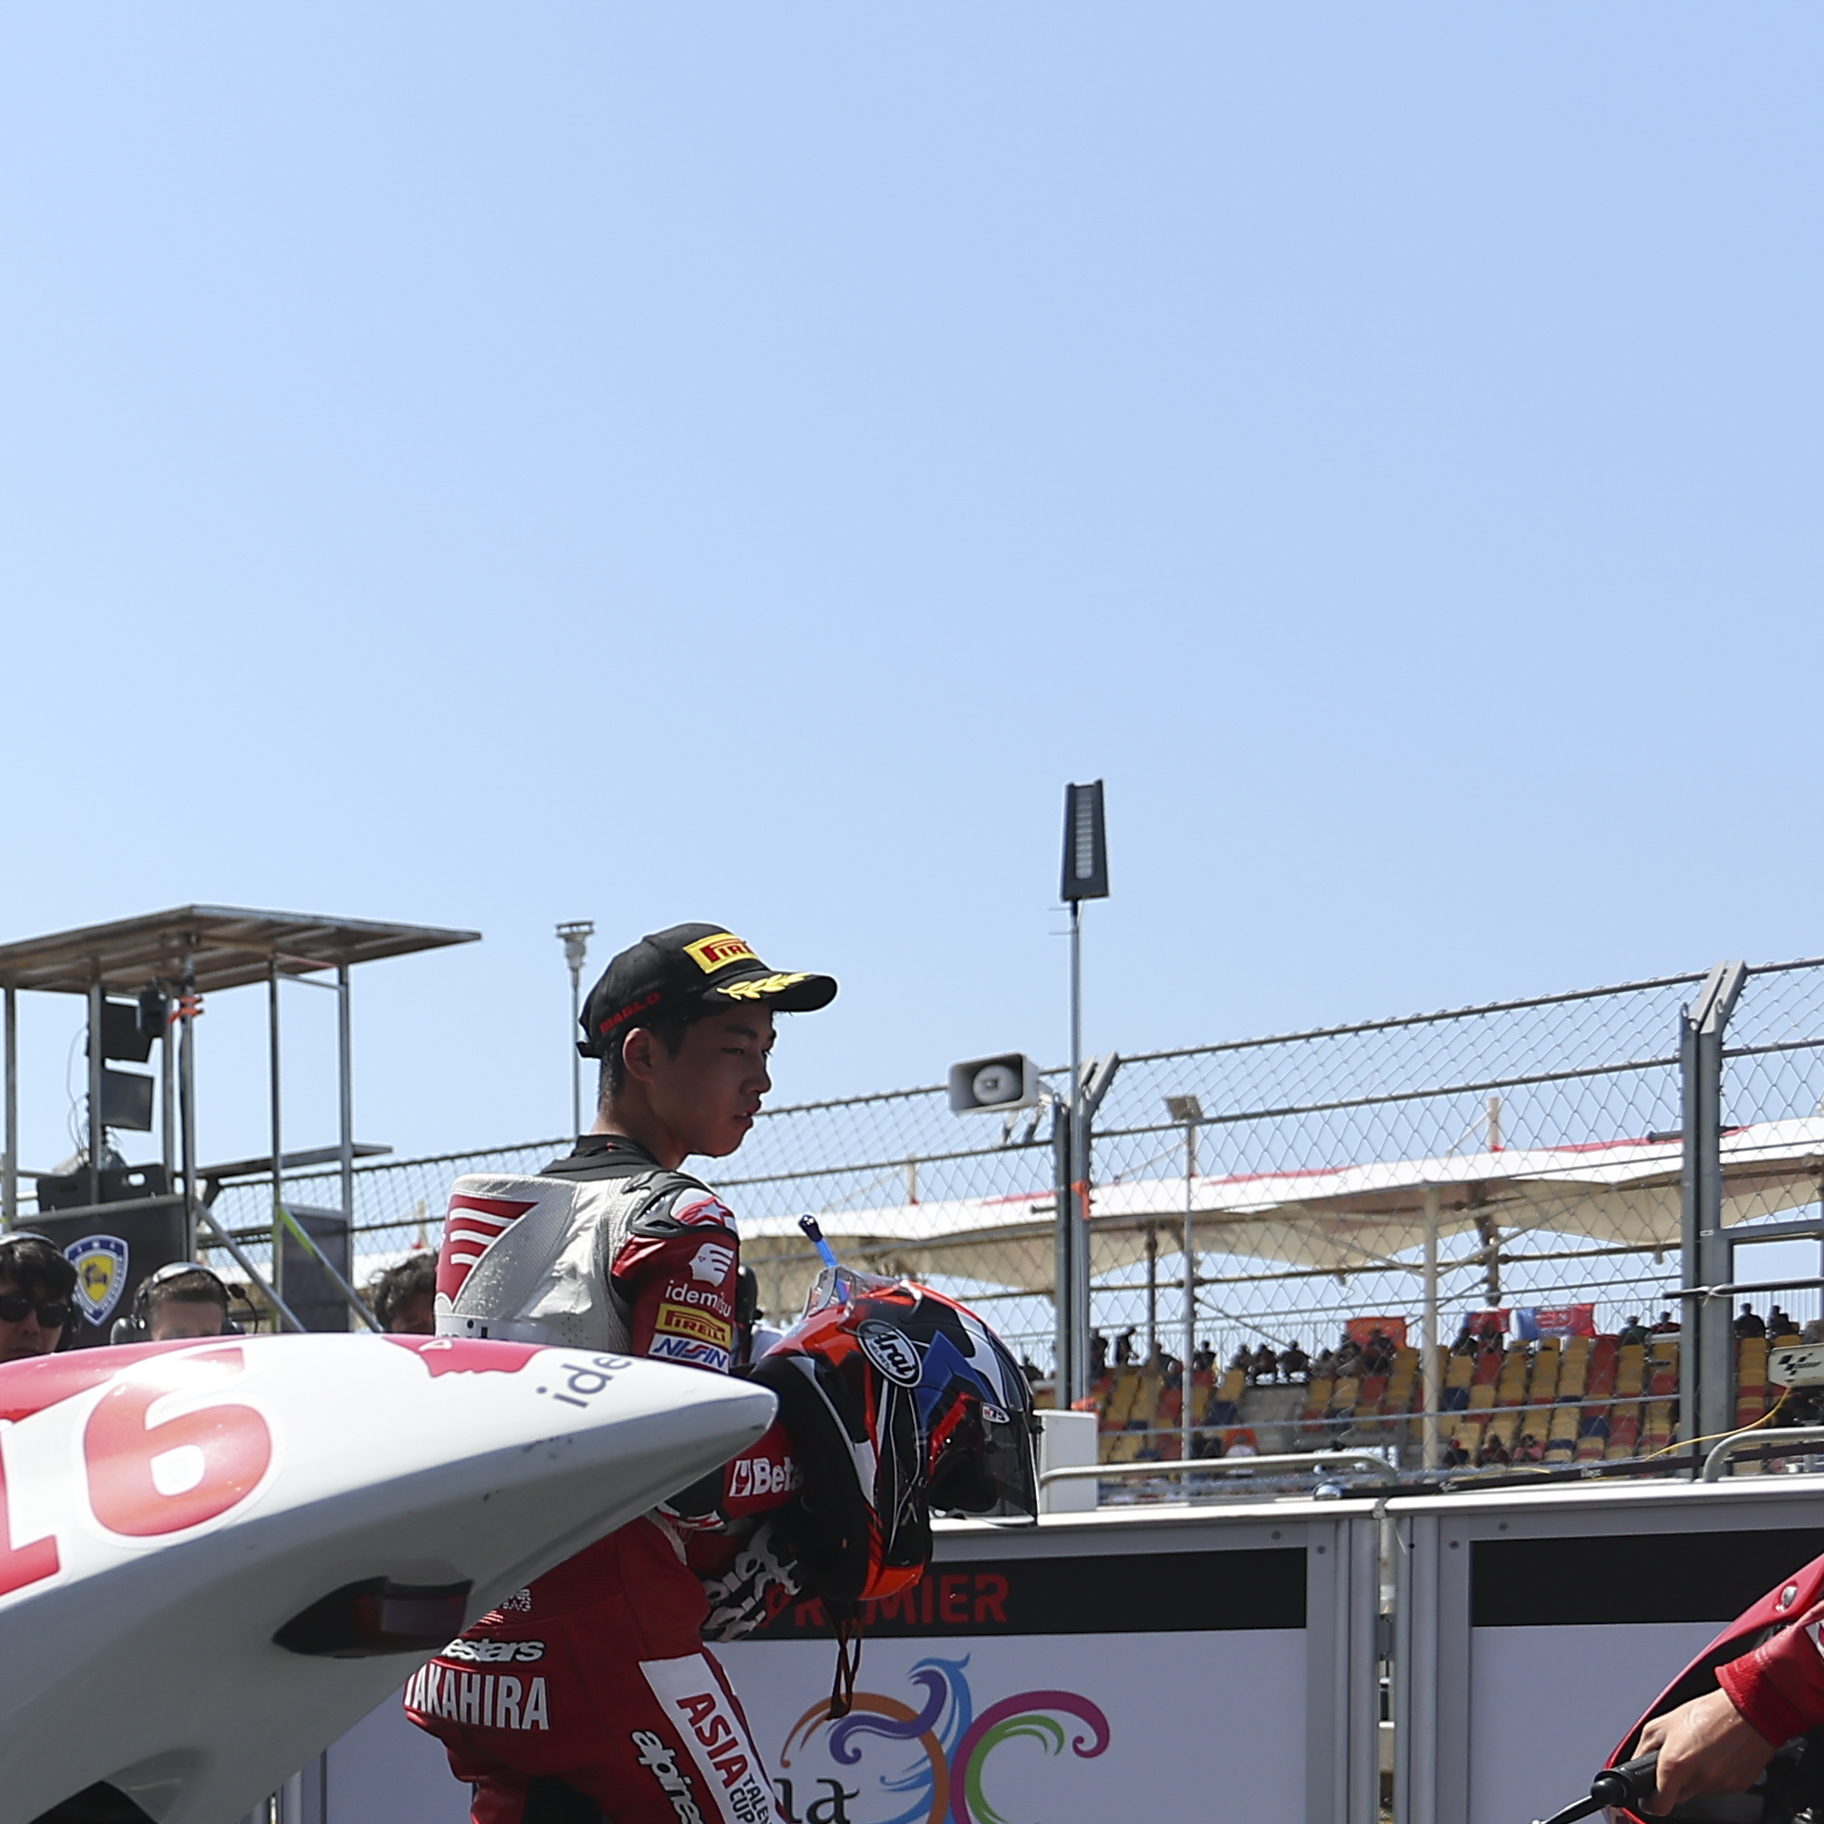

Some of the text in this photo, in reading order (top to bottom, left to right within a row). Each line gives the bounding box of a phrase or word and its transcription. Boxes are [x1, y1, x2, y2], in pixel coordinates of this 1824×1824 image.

[665, 1310, 727, 1342] PIRELLI
[865, 1327, 918, 1376] Arai
[675, 1690, 749, 1790] ASIA
